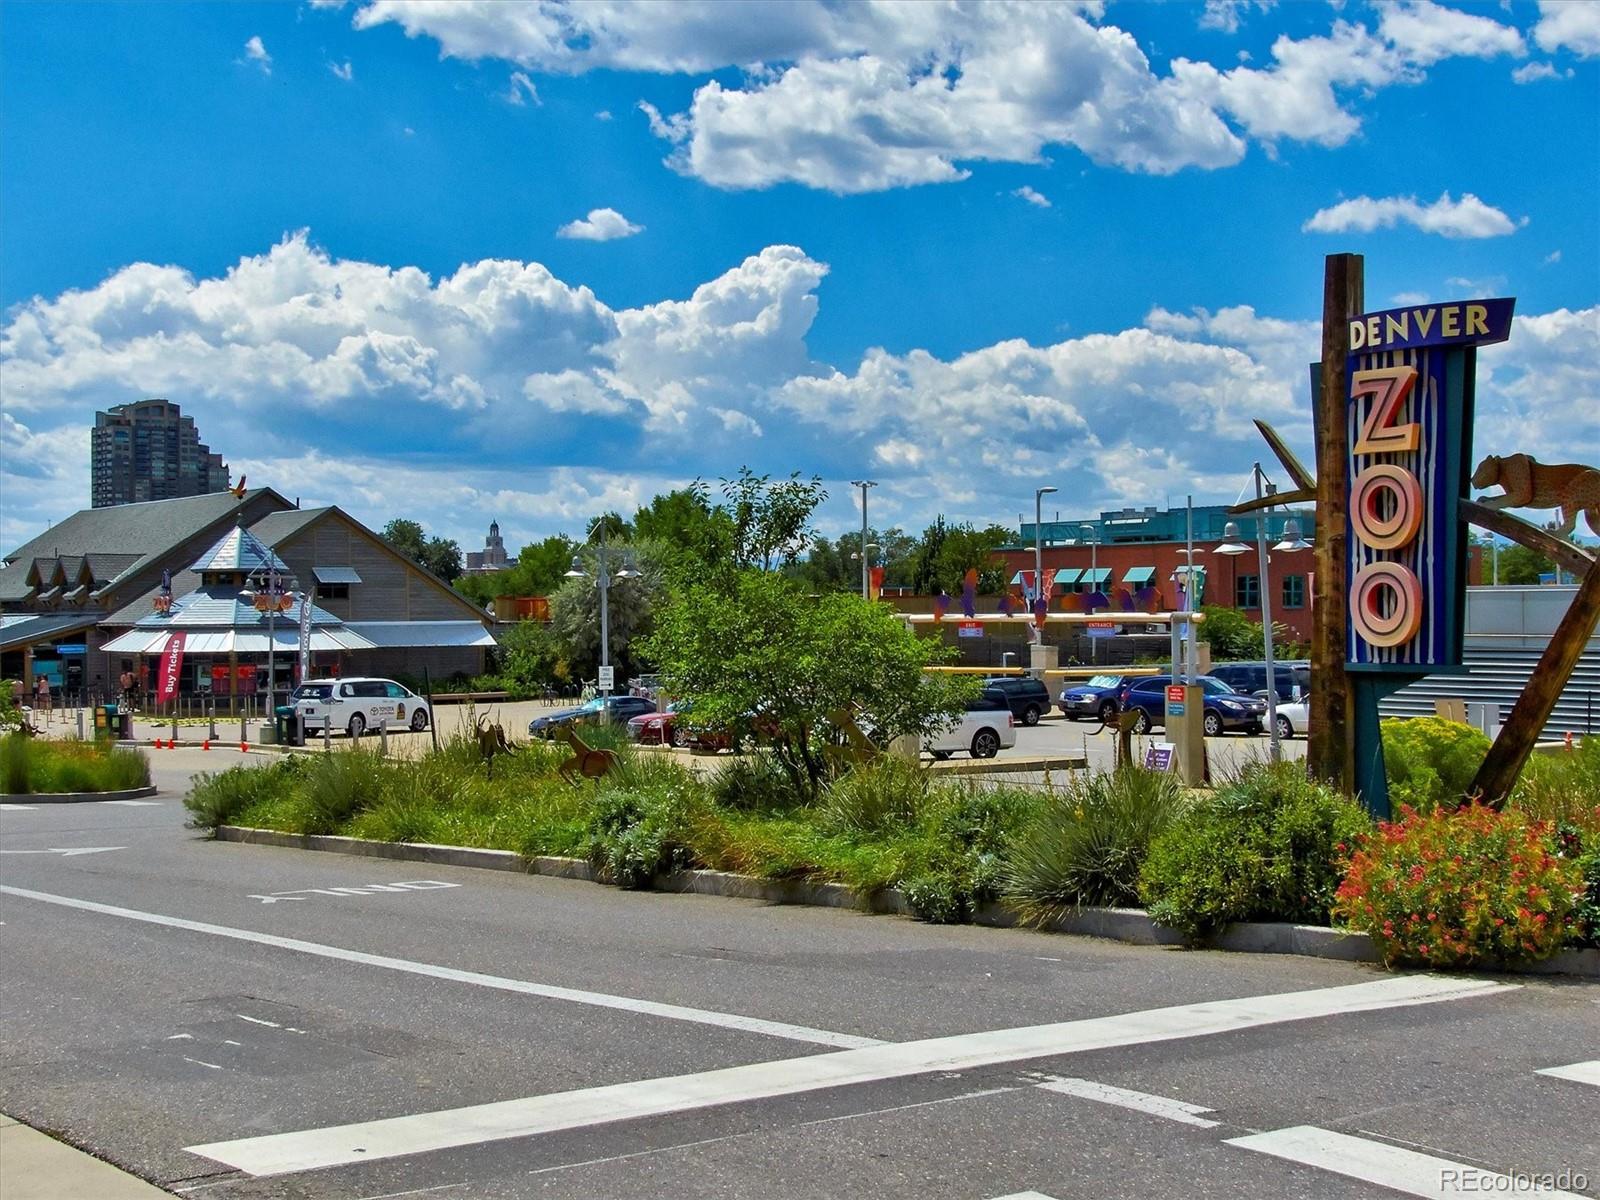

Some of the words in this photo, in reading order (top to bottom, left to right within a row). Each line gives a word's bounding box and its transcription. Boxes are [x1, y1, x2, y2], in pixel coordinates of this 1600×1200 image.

[1350, 305, 1490, 350] DENVER
[1350, 366, 1423, 647] ZOO
[168, 640, 180, 674] Tickets
[303, 618, 311, 659] TOYOTA
[165, 674, 176, 693] Buy
[247, 880, 462, 903] ONLY
